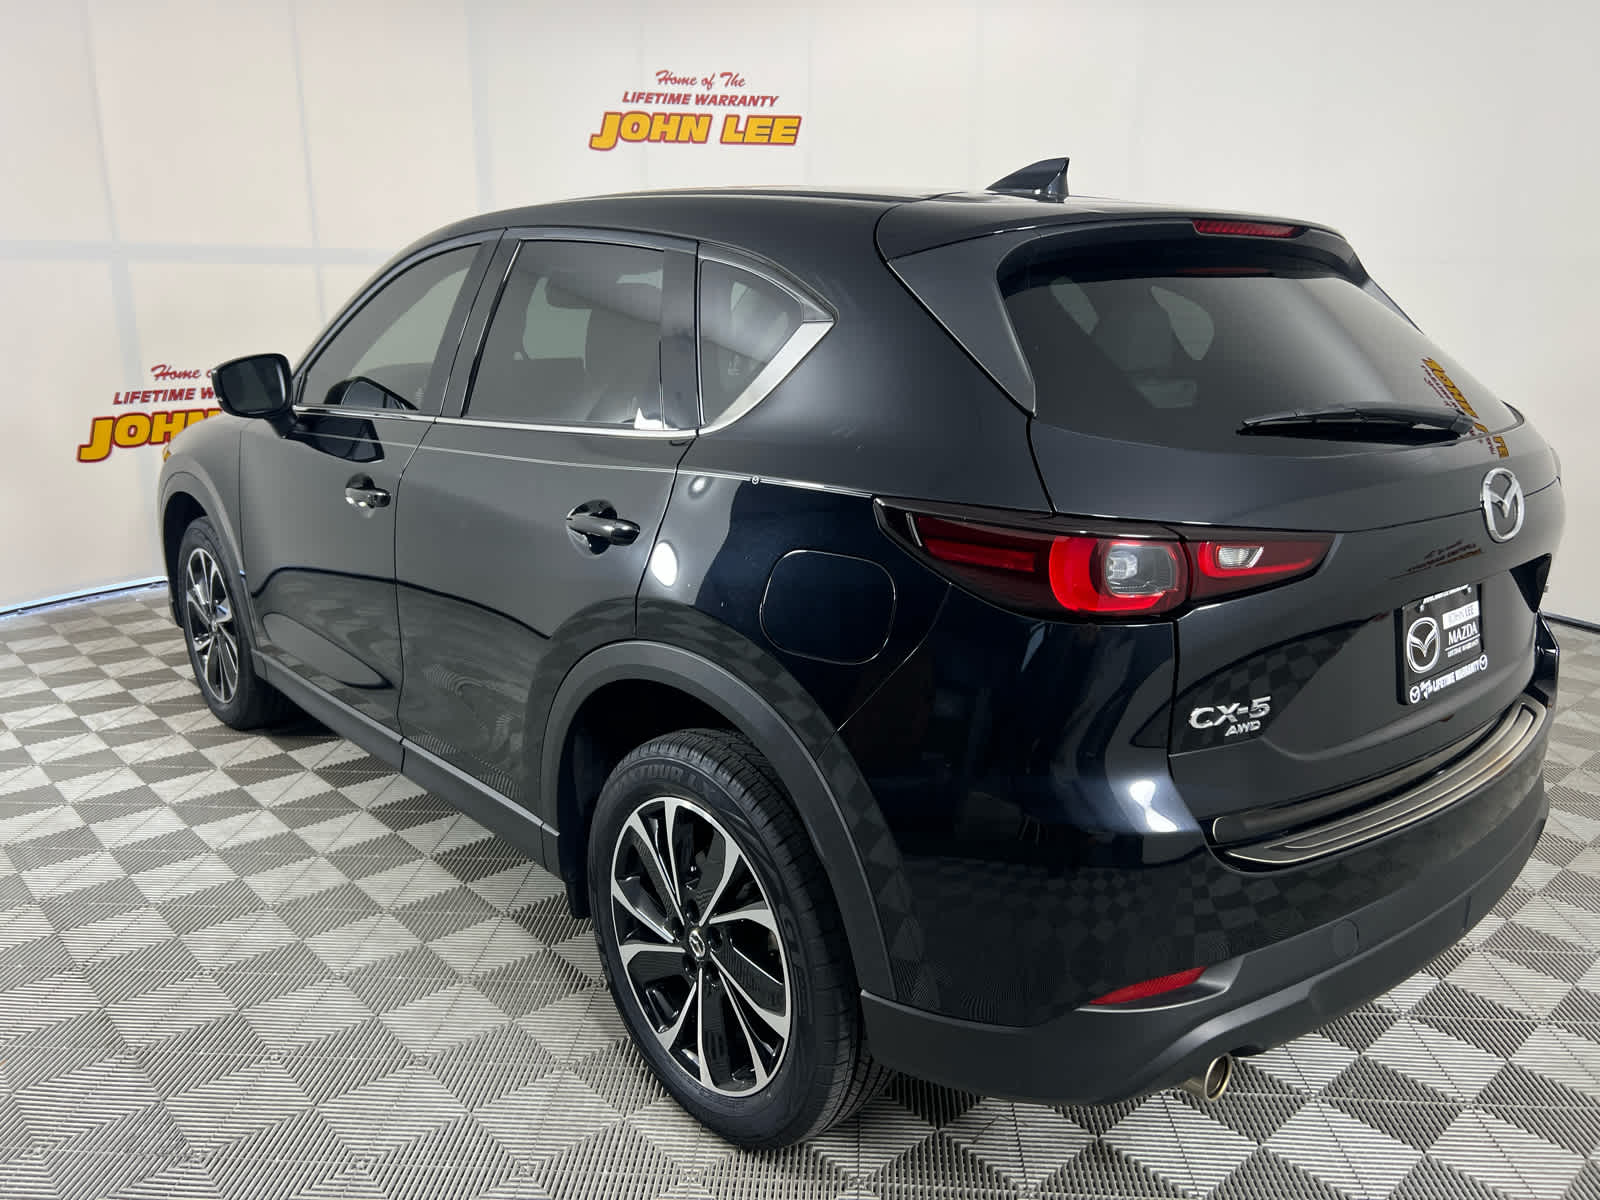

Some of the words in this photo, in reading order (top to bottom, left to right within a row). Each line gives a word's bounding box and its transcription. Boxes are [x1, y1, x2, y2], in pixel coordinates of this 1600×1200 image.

[655, 70, 697, 86] Home
[701, 73, 715, 90] of
[720, 72, 746, 87] The
[622, 91, 692, 105] LIFETIME
[695, 94, 779, 107] WARRANTY
[589, 111, 713, 151] JOHN
[720, 114, 802, 145] LEE
[150, 364, 201, 381] Home
[112, 388, 196, 405] LIFETIME
[1448, 621, 1478, 646] MAZDA
[1188, 696, 1271, 728] CX-5
[1225, 720, 1261, 736] AWD
